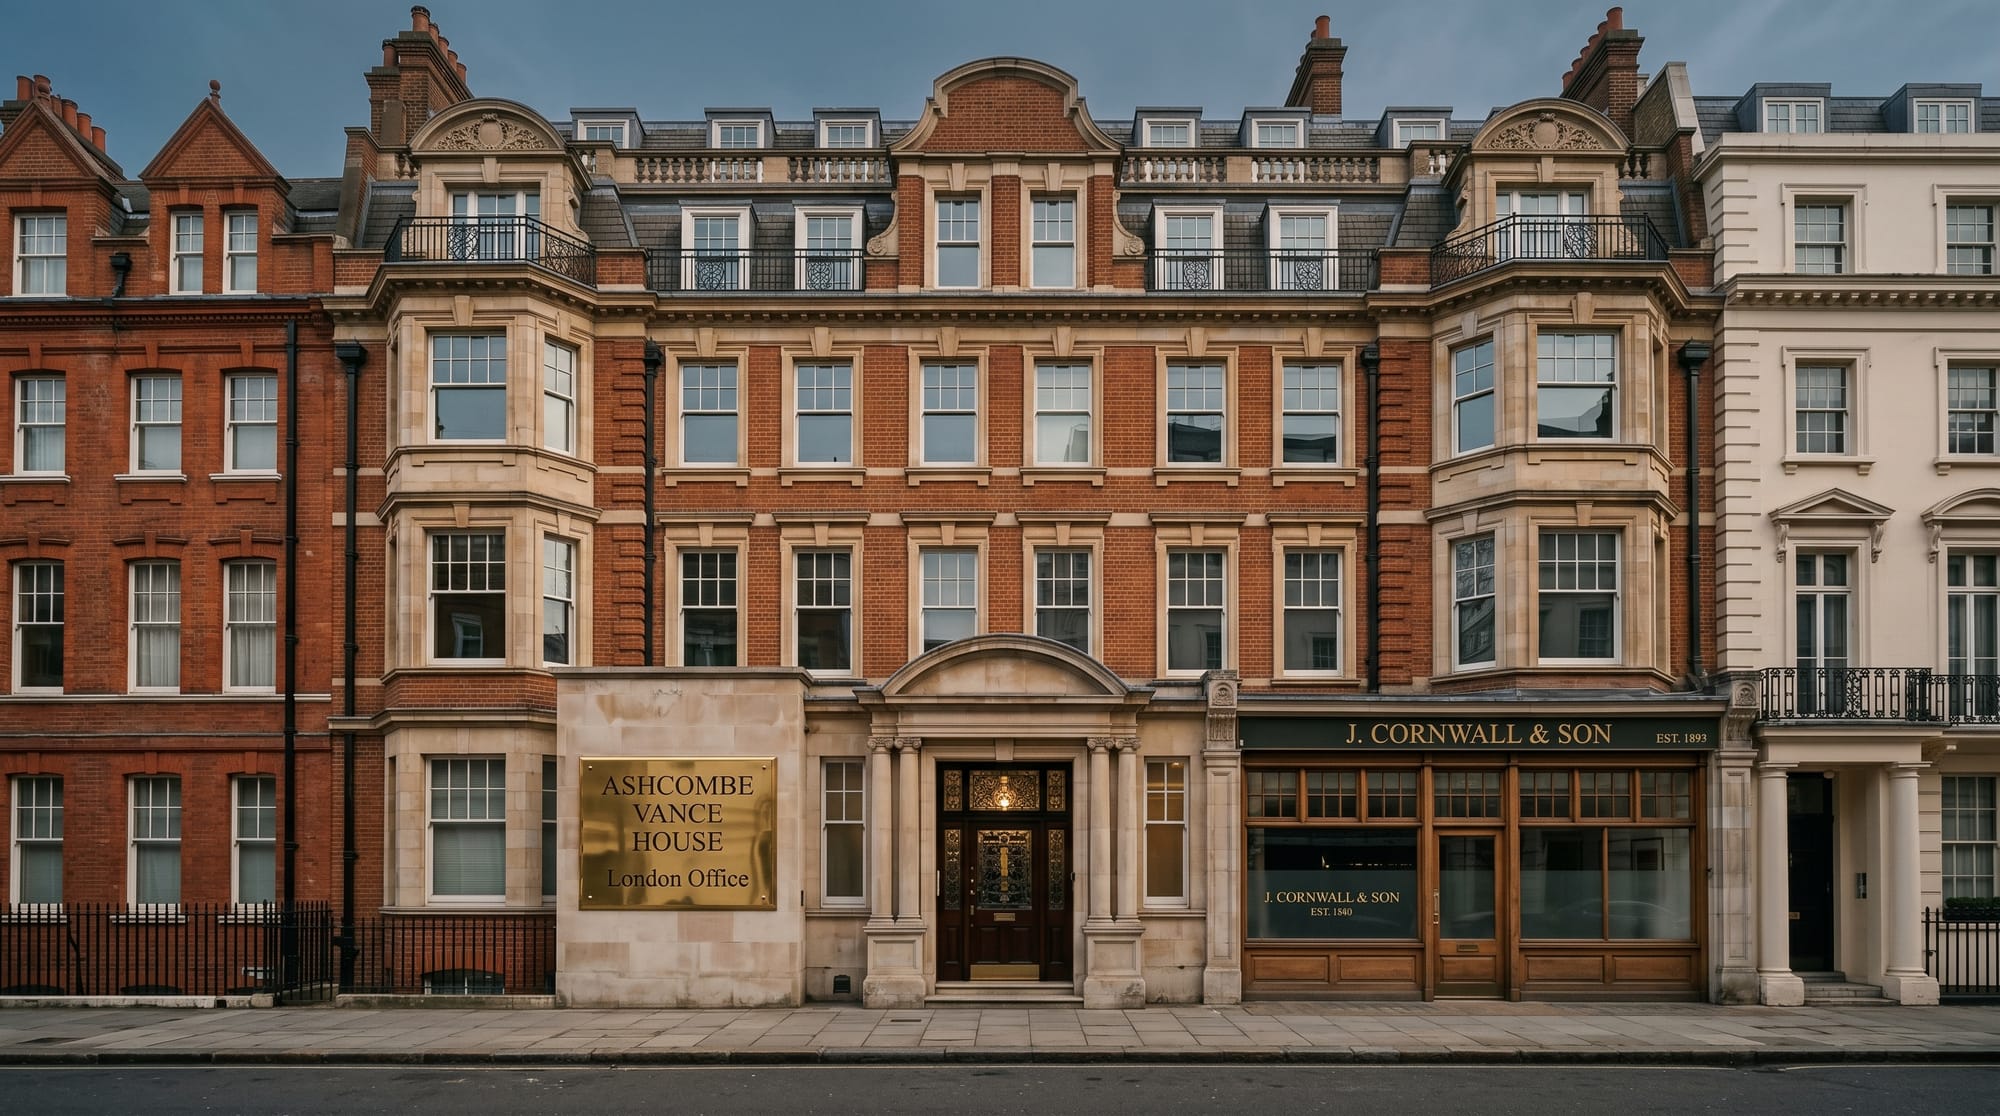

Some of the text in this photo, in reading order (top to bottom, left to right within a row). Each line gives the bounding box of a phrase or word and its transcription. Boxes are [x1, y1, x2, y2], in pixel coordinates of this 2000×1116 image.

[1346, 723, 1613, 744] J. CORNWALL & SON
[1656, 733, 1707, 744] EST. 1893
[601, 775, 754, 796] ASHCOMBE
[632, 803, 723, 824] VANCE
[632, 831, 723, 852] HOUSE
[607, 869, 749, 888] London Office
[1264, 891, 1400, 903] J. CORNWALL & SON
[1311, 907, 1331, 916] EST.
